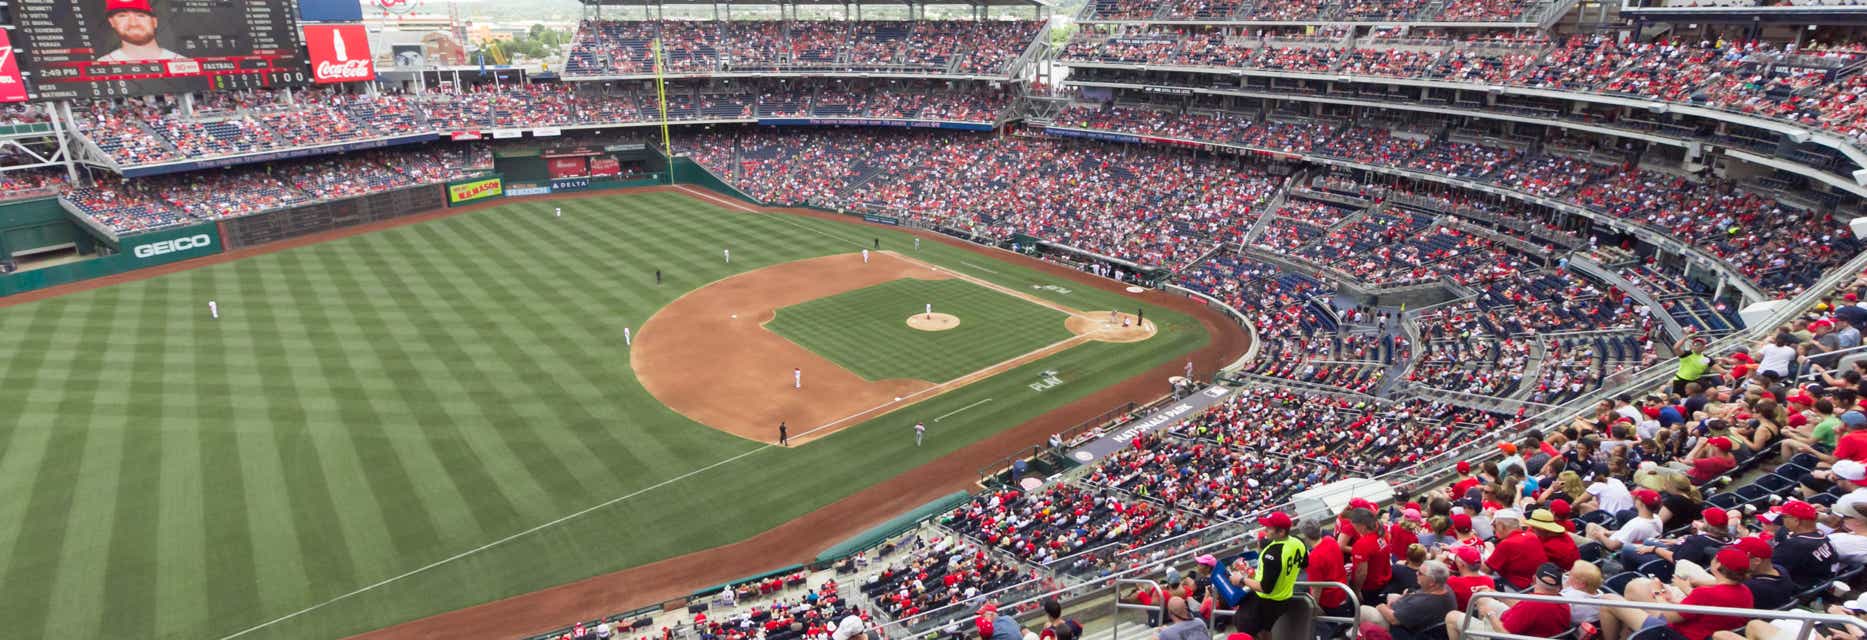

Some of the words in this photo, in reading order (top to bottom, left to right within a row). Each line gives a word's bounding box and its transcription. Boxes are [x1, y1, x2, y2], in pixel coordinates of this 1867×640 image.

[317, 60, 369, 79] Coca-Cola
[560, 181, 586, 189] DELTA
[134, 234, 211, 258] GEICO
[1112, 414, 1169, 443] NATIONALS
[1164, 403, 1193, 418] PARK
